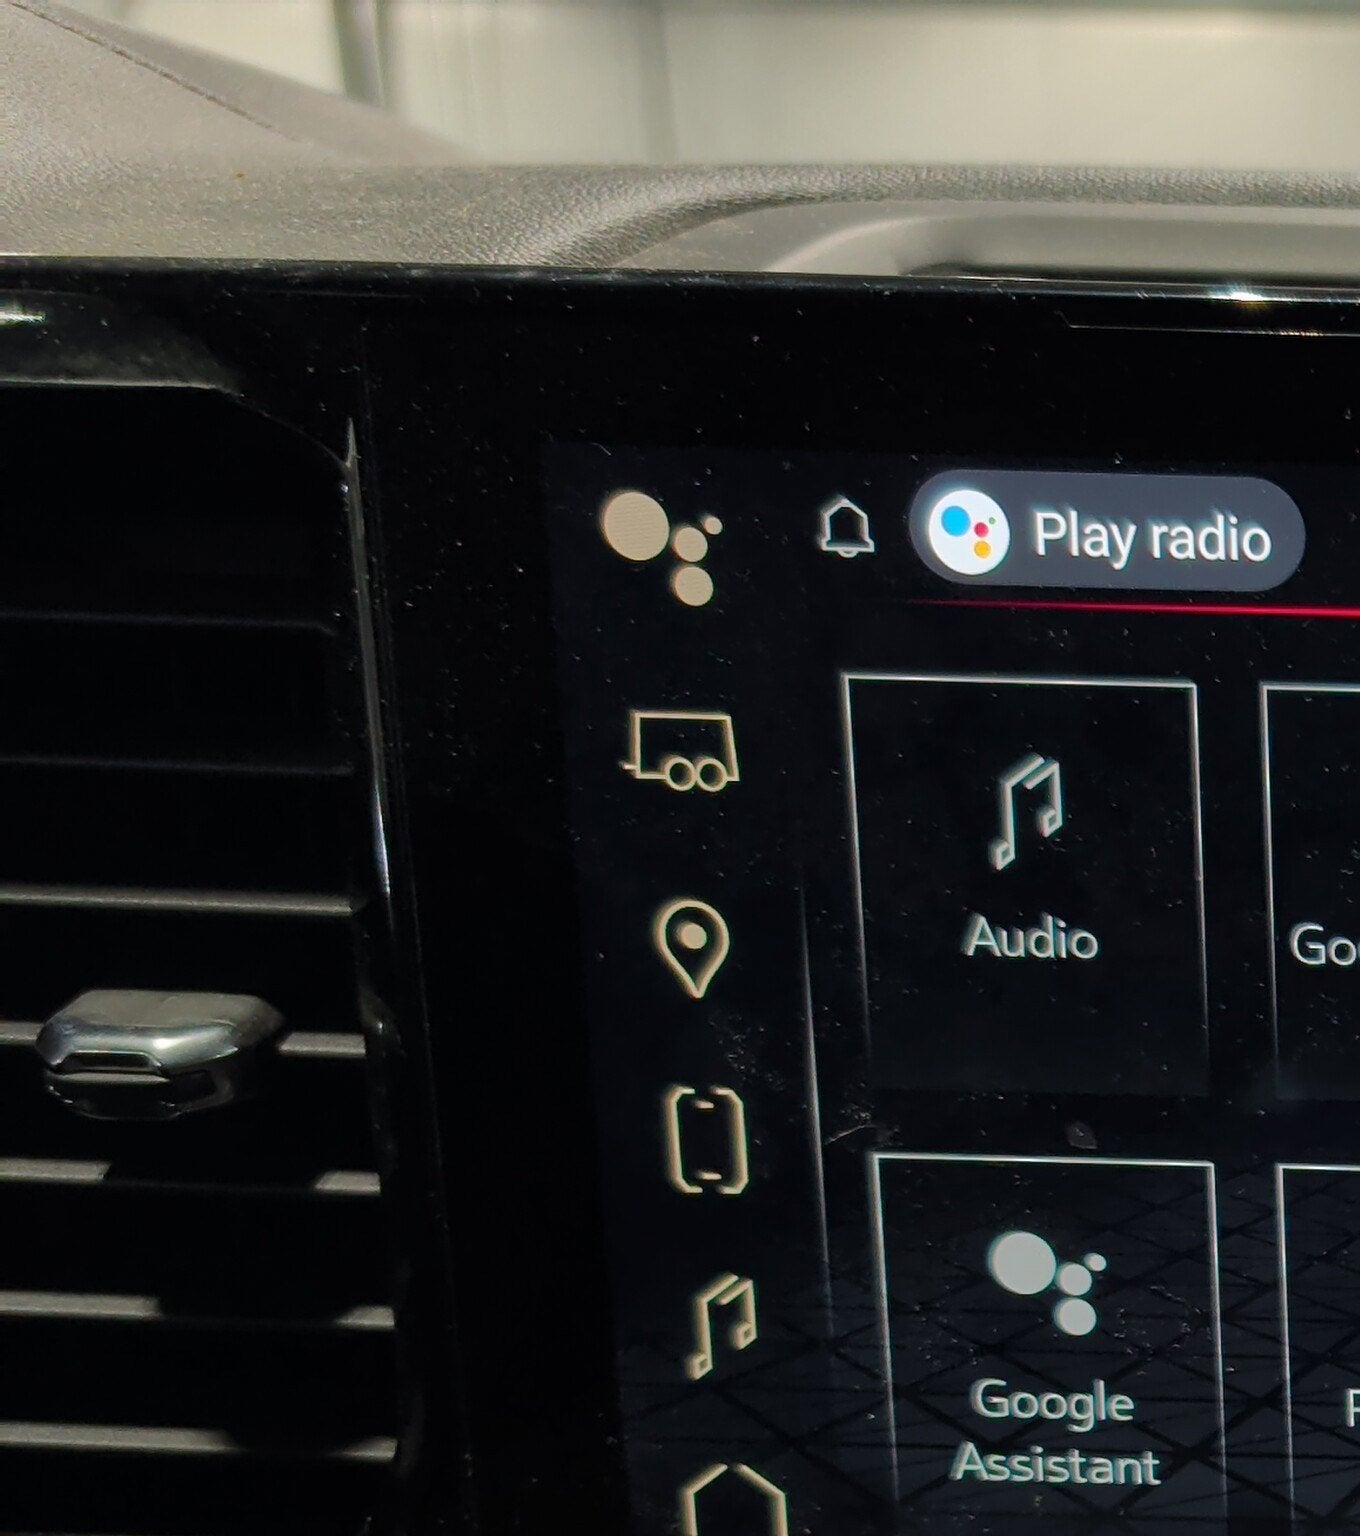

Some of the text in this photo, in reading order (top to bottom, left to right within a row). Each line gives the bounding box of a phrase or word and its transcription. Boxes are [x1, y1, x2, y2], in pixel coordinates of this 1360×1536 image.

[1033, 511, 1273, 569] Play radio
[963, 914, 1100, 961] Audio
[970, 1378, 1135, 1432] Google
[949, 1441, 1162, 1488] Assistant
